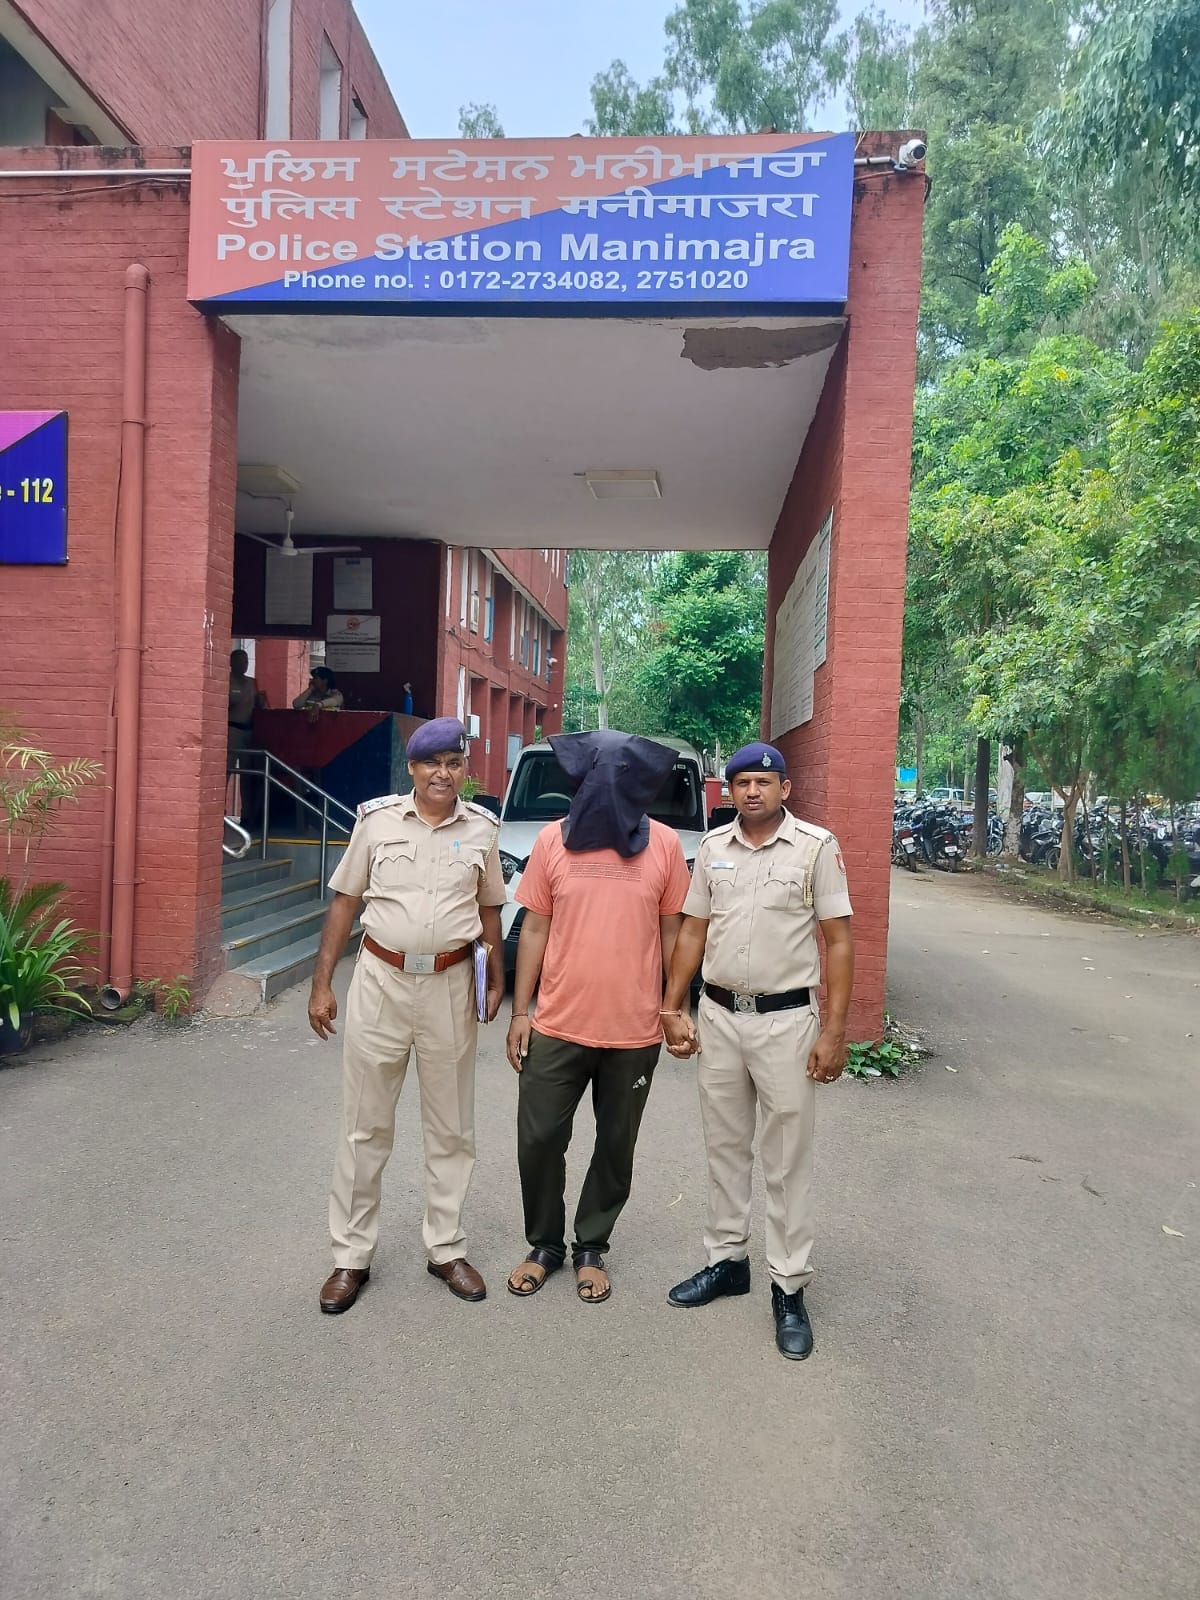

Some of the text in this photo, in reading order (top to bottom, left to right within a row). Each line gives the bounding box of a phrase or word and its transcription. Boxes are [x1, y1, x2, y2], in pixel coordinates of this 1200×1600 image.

[220, 145, 827, 190] ਪੁਲਿਸ ਸਟੇਸ਼ਨ ਮਨੀਮਾਜਰਾ
[220, 185, 820, 228] पुलिस स्टेशन मनीमाजरा
[217, 232, 815, 267] Police Station Manimajra
[284, 270, 366, 288] Phone
[374, 274, 414, 289] no.
[440, 271, 627, 292] 0172-2734082,
[636, 270, 749, 289] 2751020
[21, 477, 54, 503] 112
